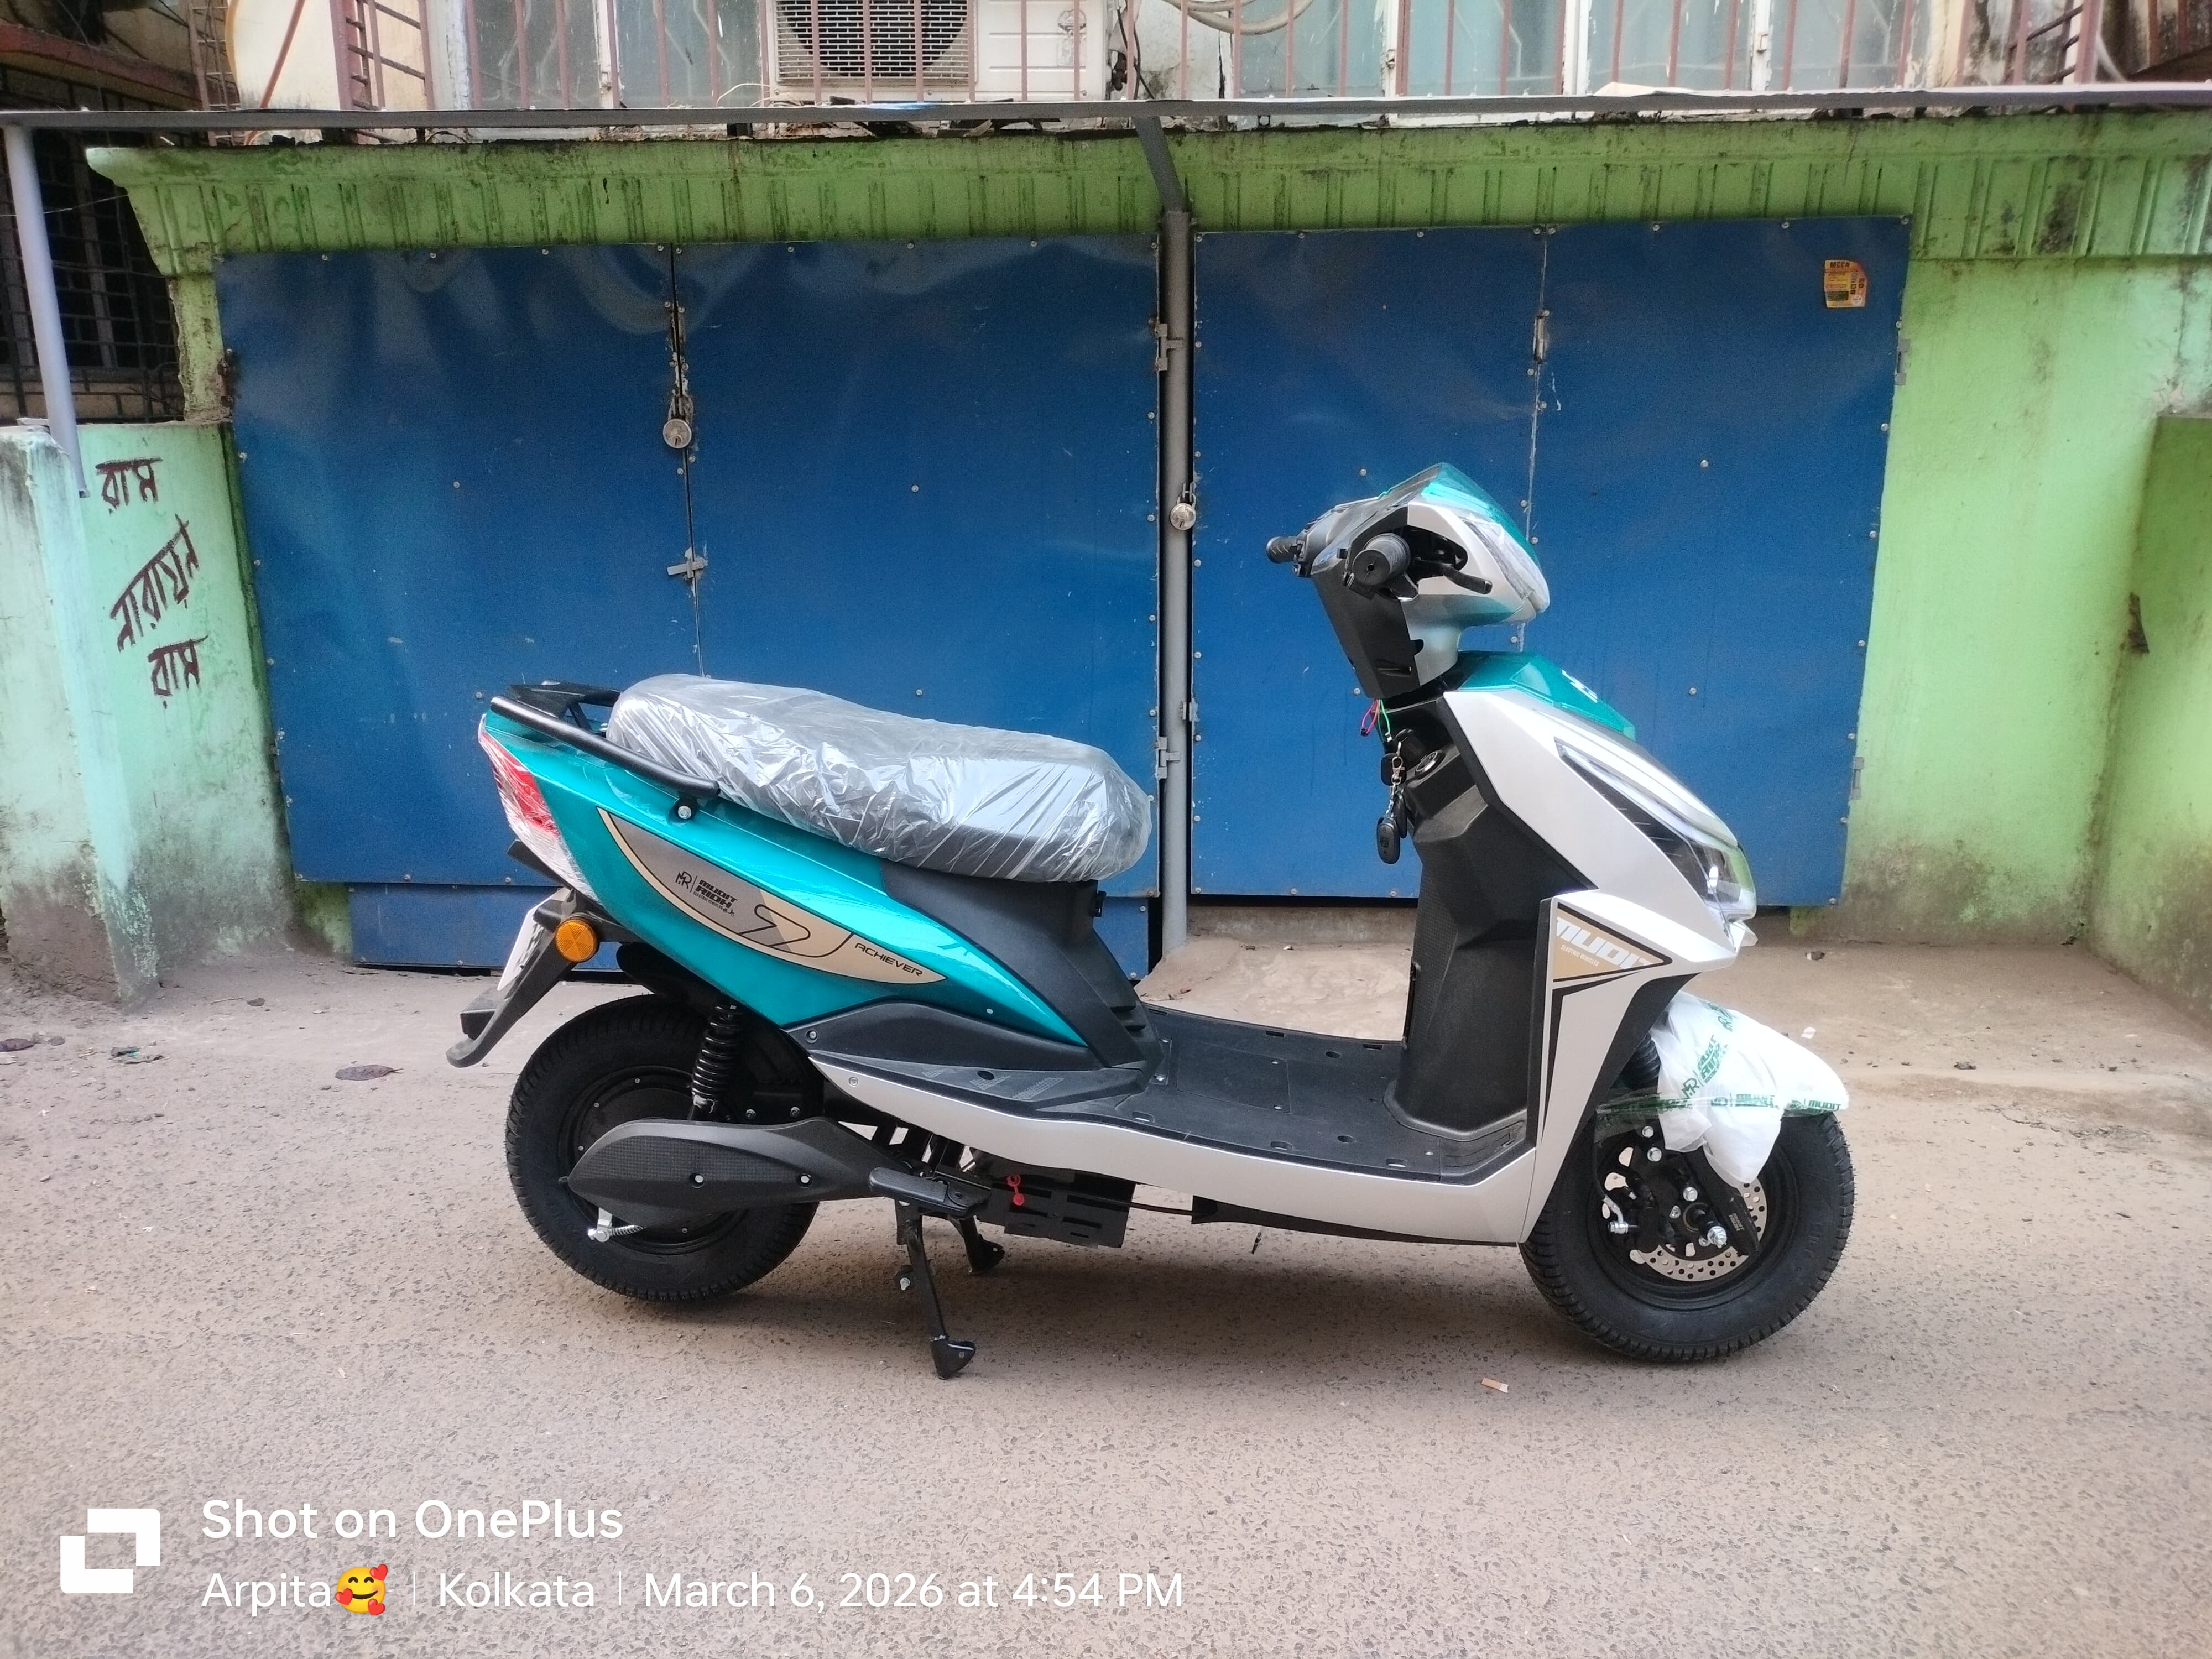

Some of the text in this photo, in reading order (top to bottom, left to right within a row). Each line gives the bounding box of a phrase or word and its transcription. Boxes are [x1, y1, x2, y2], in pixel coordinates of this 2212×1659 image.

[95, 457, 164, 514] রাম
[147, 635, 209, 709] রাম
[698, 879, 738, 903] MUDIT
[854, 942, 923, 977] ACHIEVER
[1560, 943, 1600, 967] ELECTRIC VEHICLES
[1808, 1099, 1842, 1111] MUDIT
